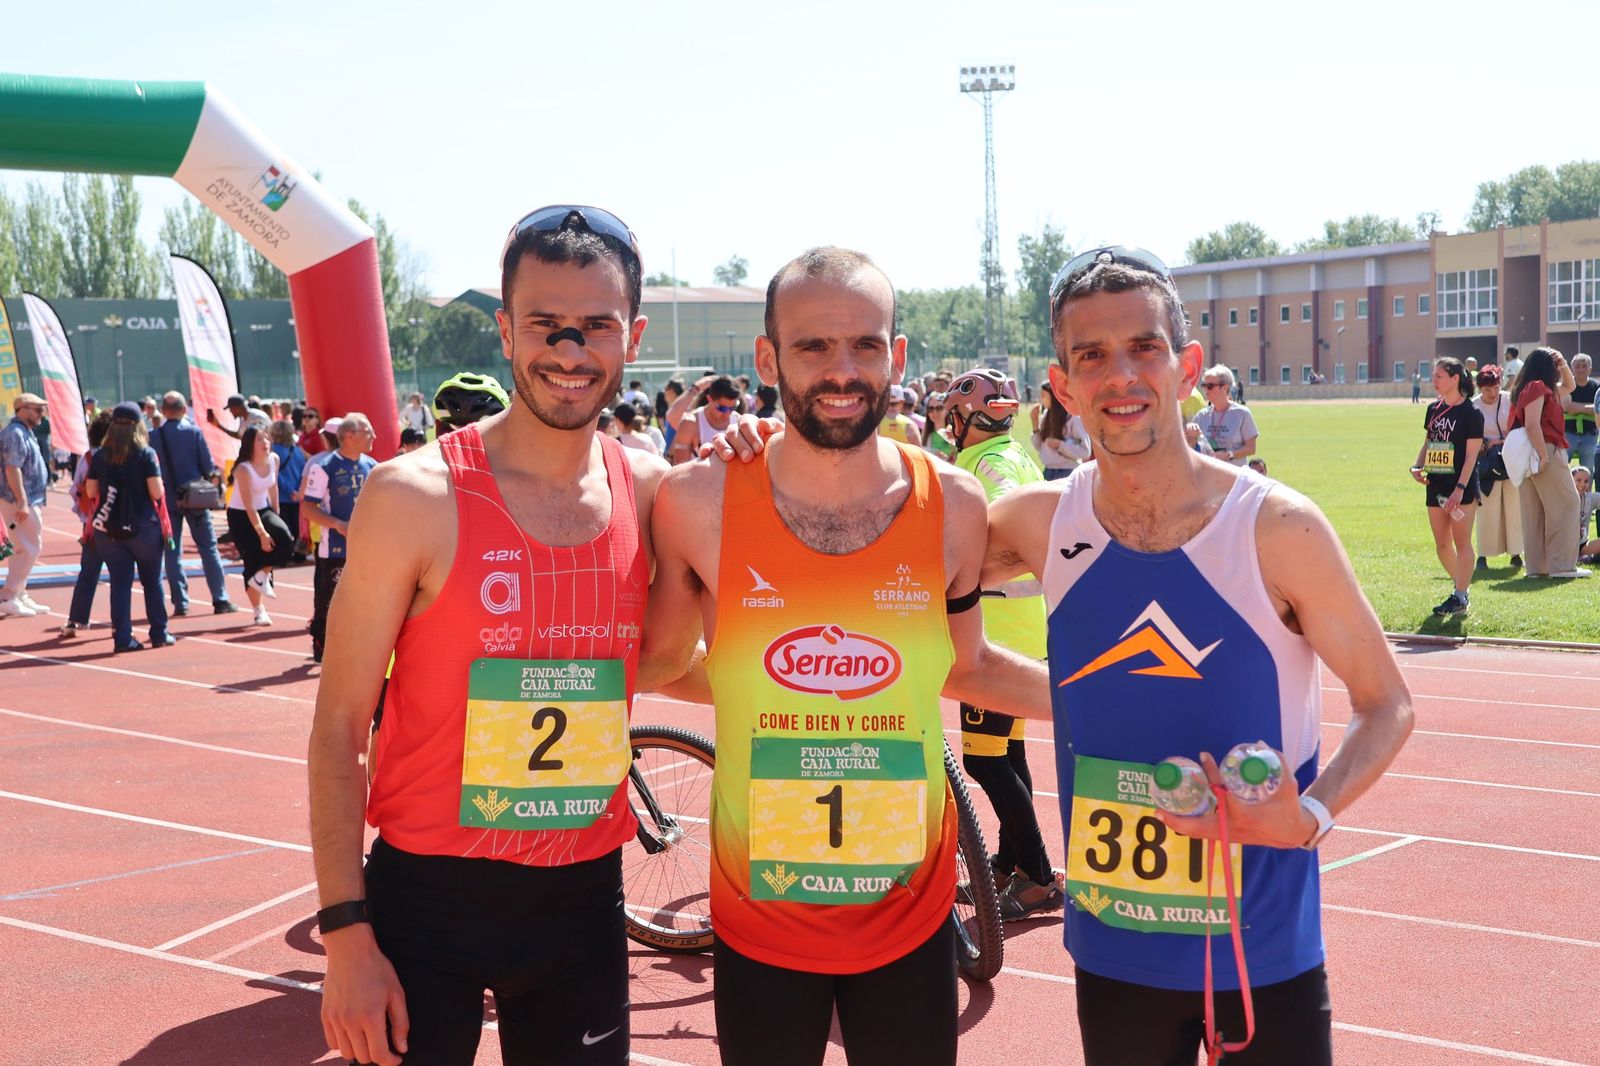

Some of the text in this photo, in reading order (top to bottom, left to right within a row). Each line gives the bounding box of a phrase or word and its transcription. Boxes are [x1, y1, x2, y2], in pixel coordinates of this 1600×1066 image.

[206, 183, 279, 249] DE ZAMORA
[217, 178, 290, 240] AYUNTAMIENTO
[126, 317, 168, 331] CAJA
[1427, 451, 1449, 465] 1446
[482, 550, 523, 562] 42K
[873, 590, 930, 602] SERRANO
[479, 622, 522, 643] ada
[537, 622, 610, 639] vistasol
[777, 645, 890, 678] Serrano
[521, 679, 596, 691] CAJA RURAL
[760, 713, 906, 732] COME BIEN Y CORRE
[528, 706, 568, 771] 2
[800, 758, 880, 770] CAJA RURAL
[514, 799, 609, 818] CAJA RURA
[815, 784, 843, 849] 1
[1085, 808, 1204, 883] 381
[801, 875, 893, 893] CAJA RUR
[1114, 900, 1231, 924] CAJA RURAL
